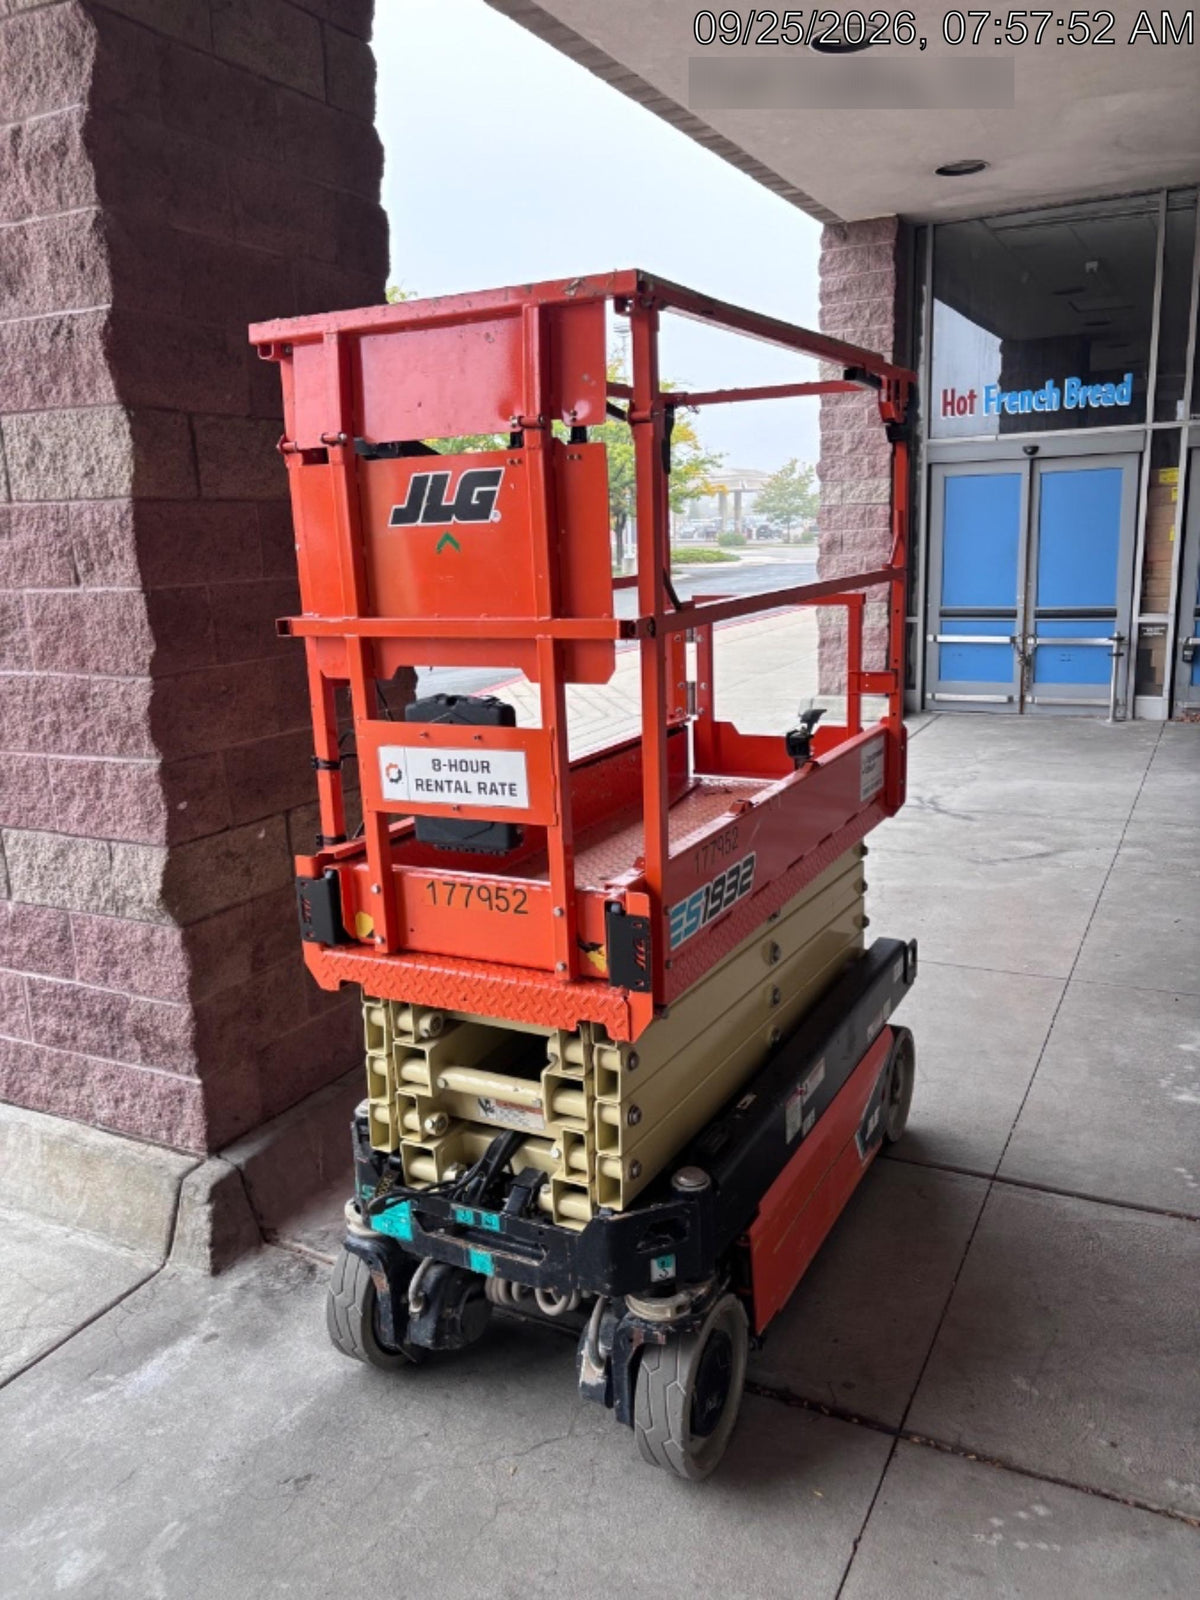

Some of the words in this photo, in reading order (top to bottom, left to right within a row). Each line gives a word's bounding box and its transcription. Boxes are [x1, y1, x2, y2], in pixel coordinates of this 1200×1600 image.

[941, 388, 977, 418] Hot
[983, 379, 1060, 417] French
[1064, 373, 1133, 410] Bread
[388, 466, 505, 527] JLG
[415, 778, 472, 795] RENTAL
[477, 782, 518, 797] RATE
[431, 758, 491, 774] 8-HOUR
[695, 826, 738, 875] 177952
[427, 881, 528, 914] 177952
[670, 852, 756, 950] ES1932
